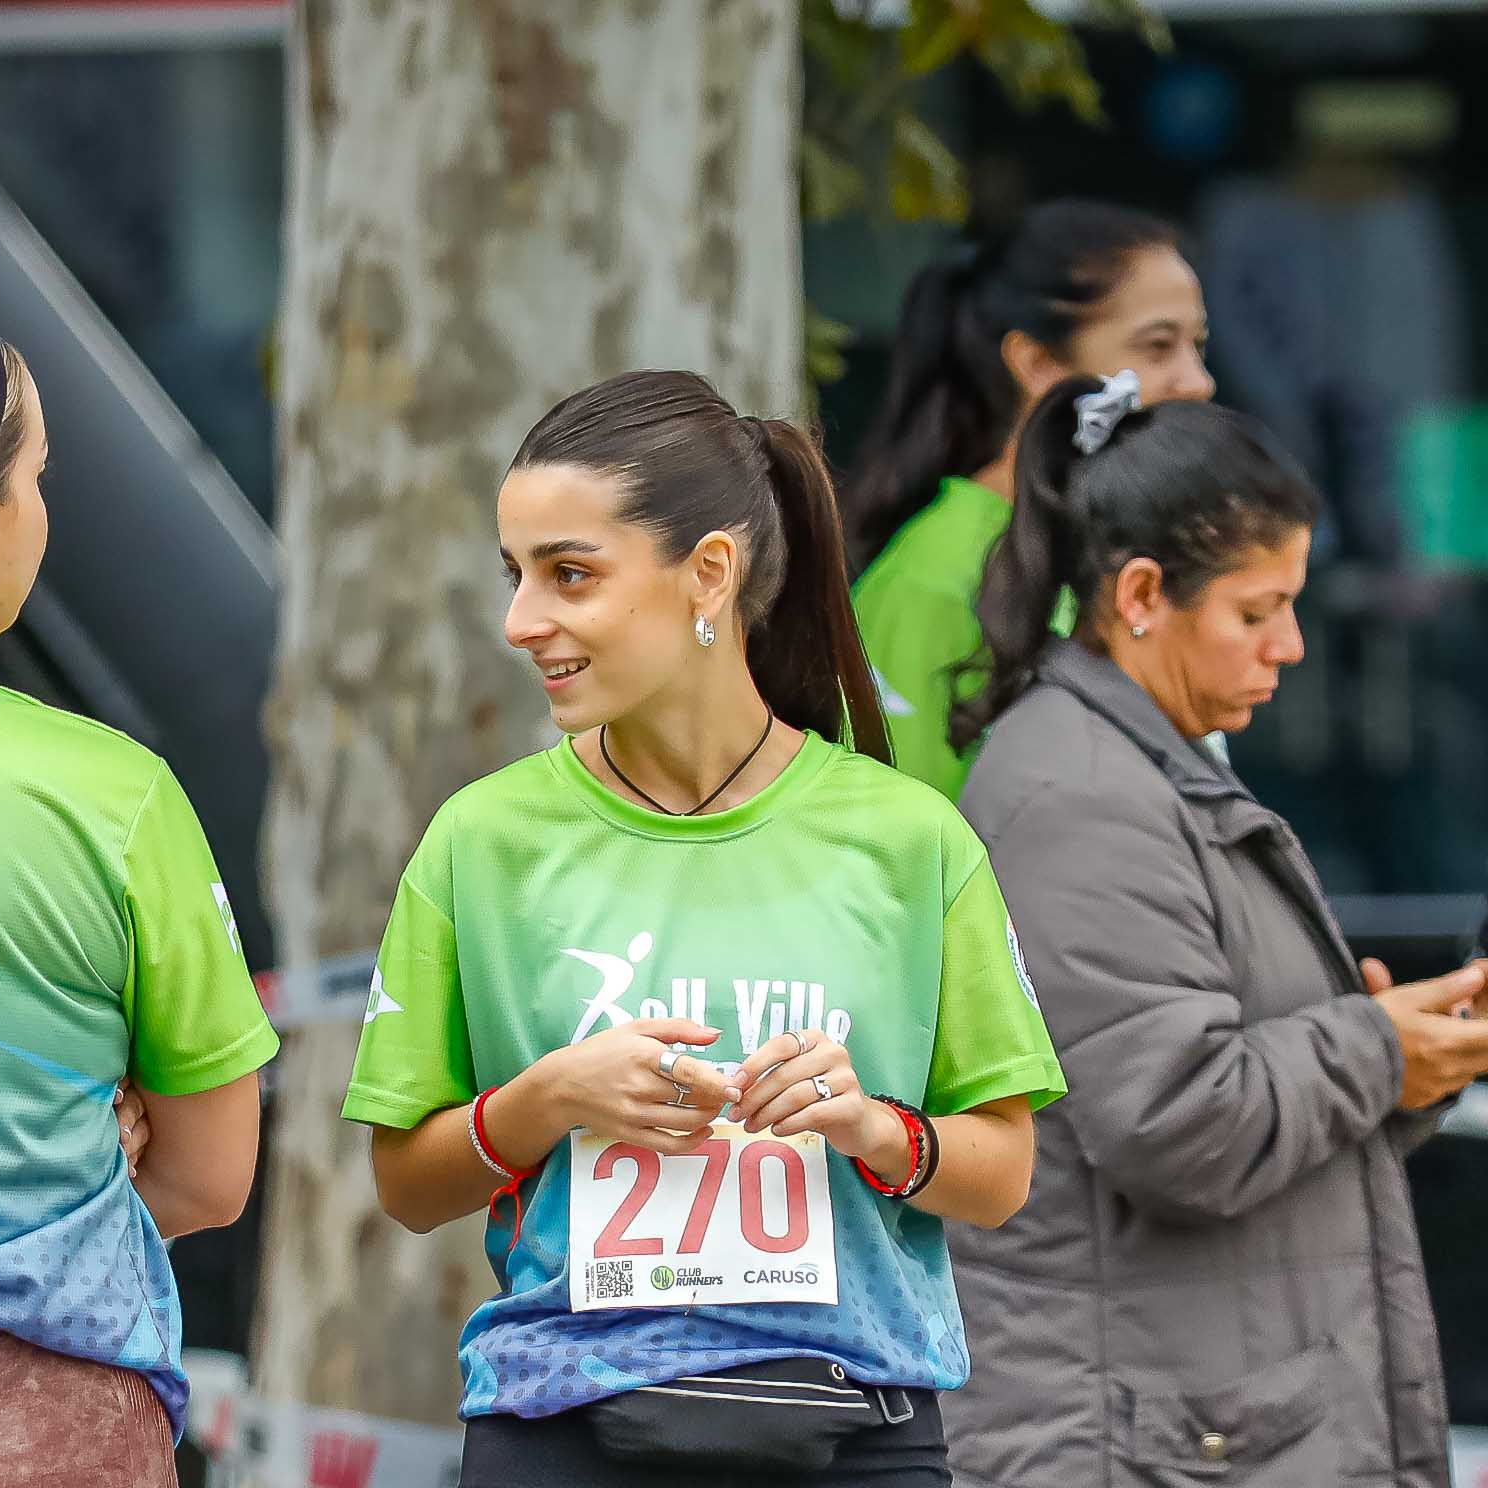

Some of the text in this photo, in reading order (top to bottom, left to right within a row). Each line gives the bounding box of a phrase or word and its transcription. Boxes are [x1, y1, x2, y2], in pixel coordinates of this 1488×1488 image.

[593, 1138, 810, 1259] 270
[676, 1267, 702, 1277] CLUB
[743, 1269, 819, 1285] CARUSO
